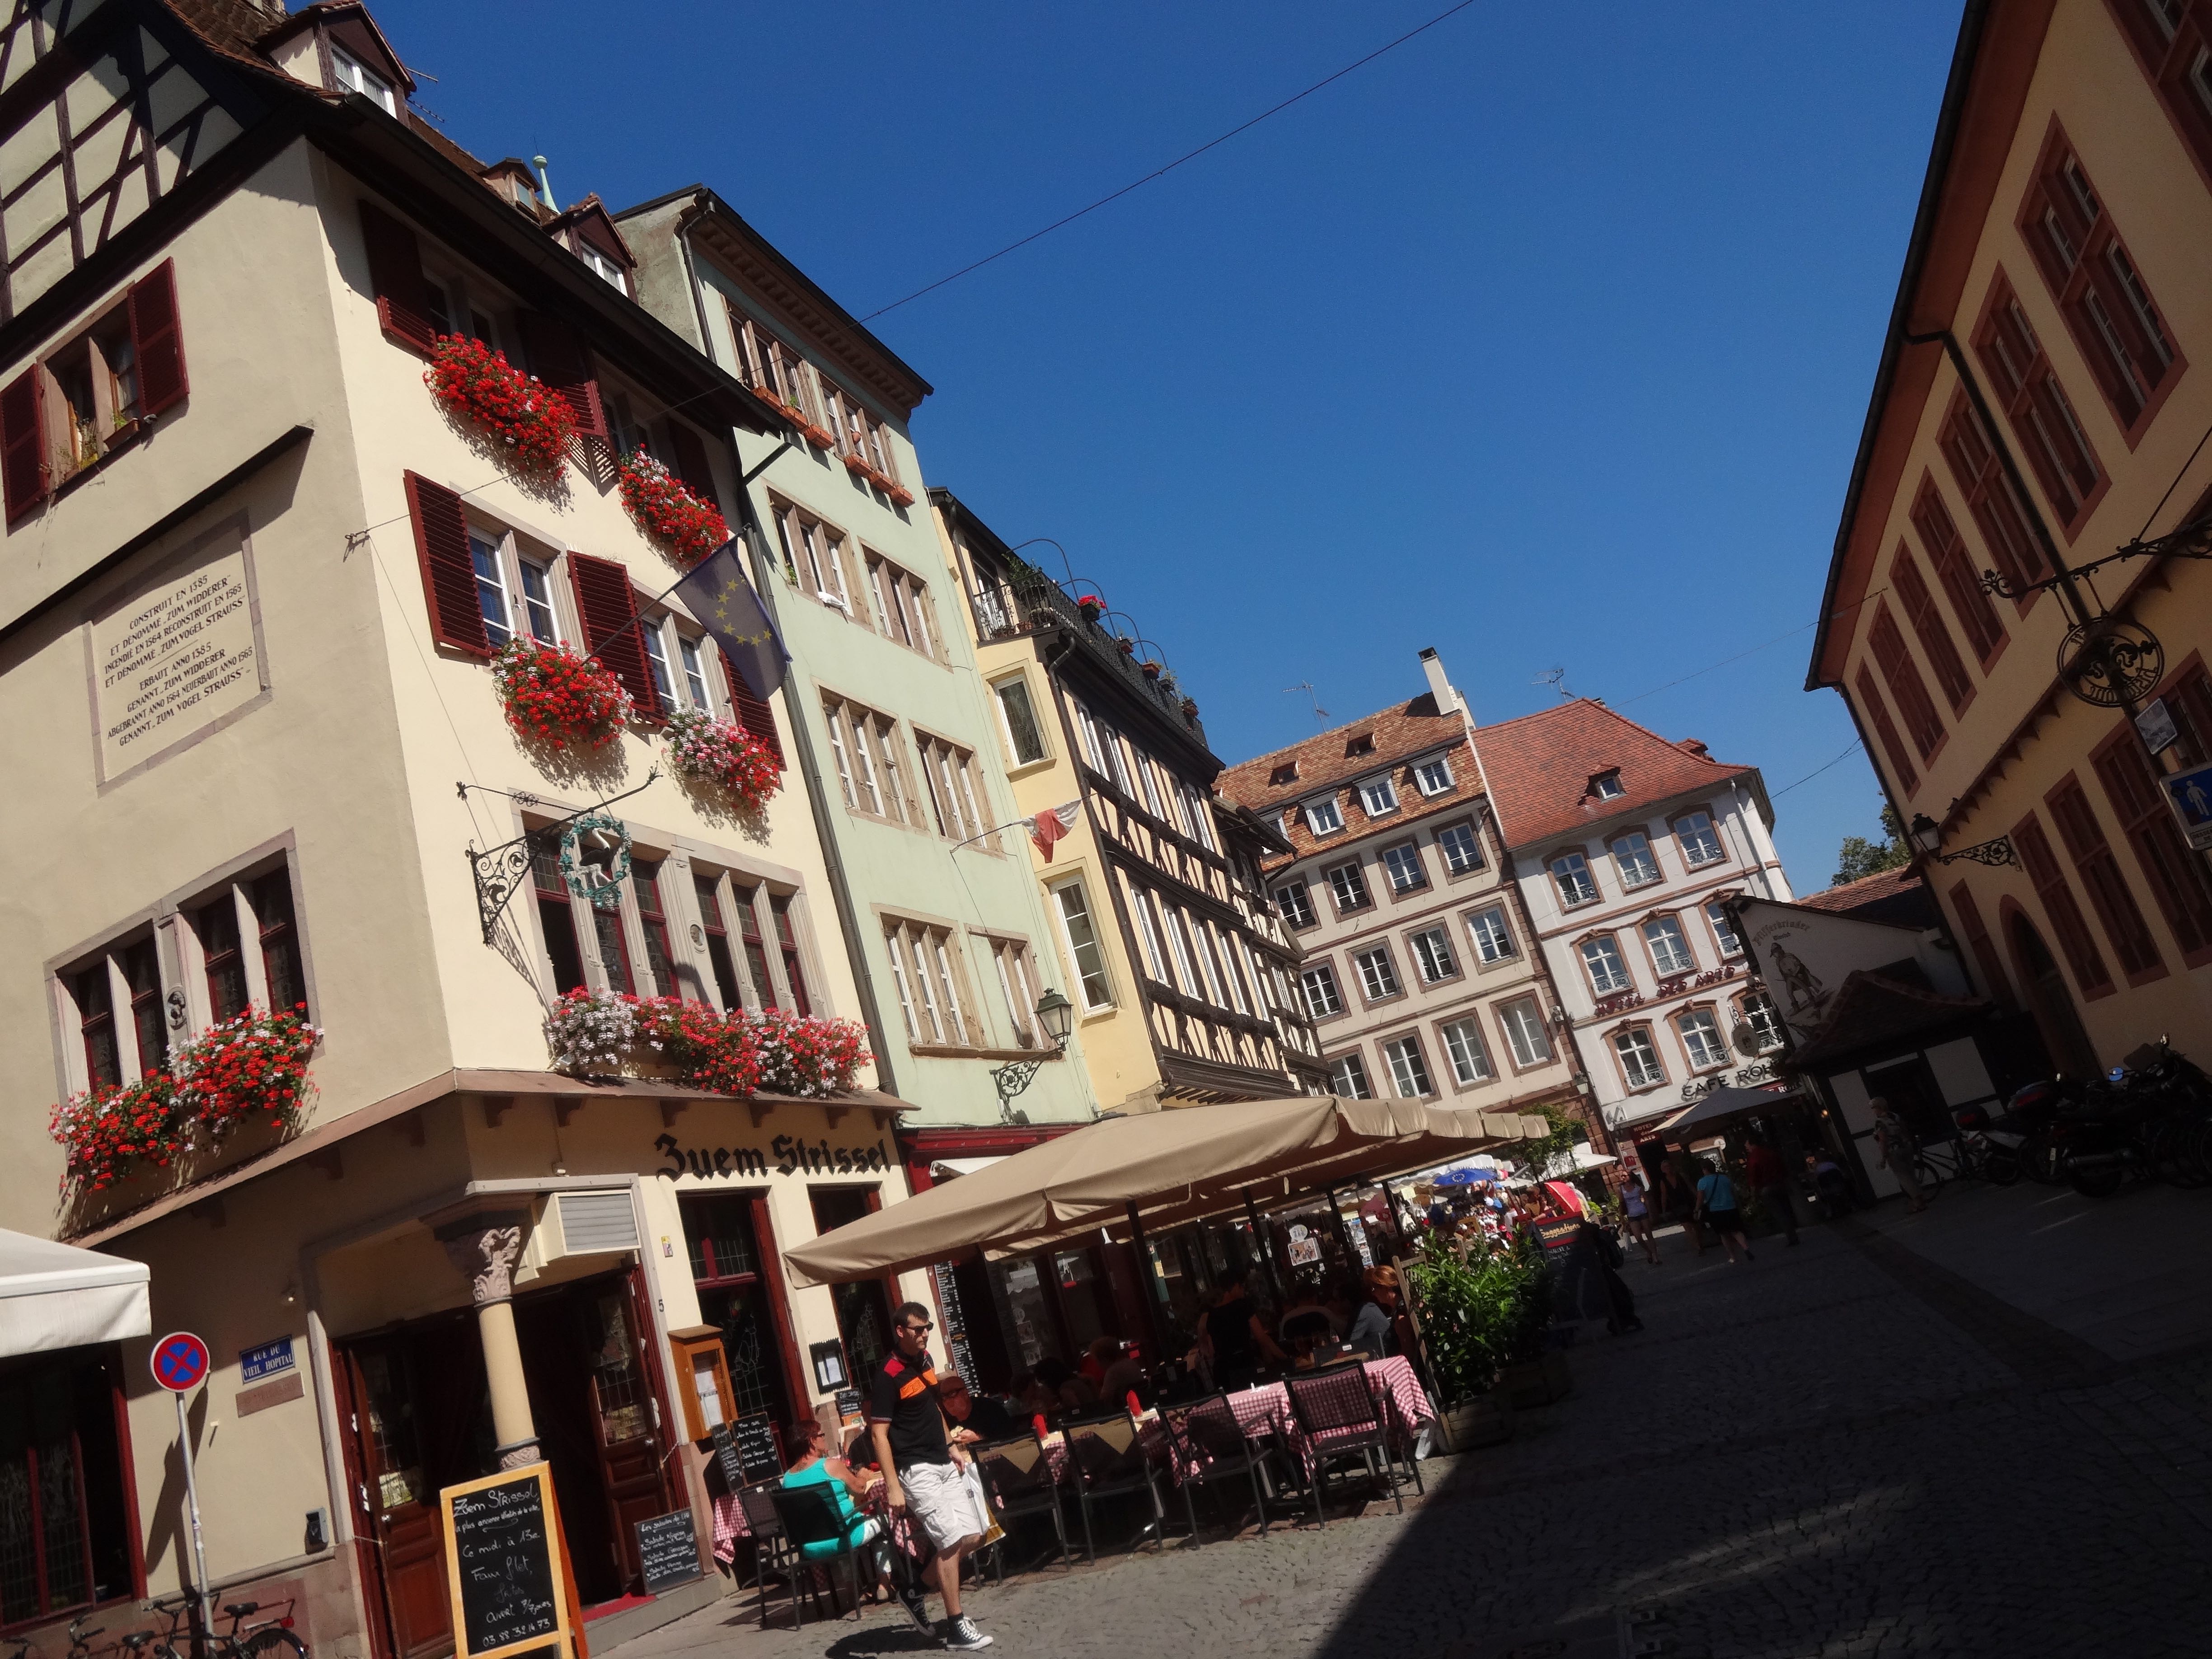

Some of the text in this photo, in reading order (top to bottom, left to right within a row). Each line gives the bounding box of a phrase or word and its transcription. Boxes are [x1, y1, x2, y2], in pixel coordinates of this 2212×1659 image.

[129, 575, 207, 629] CONSTRUIT EN 1385
[136, 642, 144, 655] EN
[164, 600, 212, 637] RECONSTRUIT
[215, 594, 224, 606] EN
[226, 583, 242, 600] 1565
[105, 675, 114, 688] ET
[179, 622, 205, 640] VOGEL
[110, 643, 119, 656] ET
[139, 642, 211, 691] ERBAUT ANNO 1385
[108, 709, 146, 739] ABGEBRANNT
[149, 699, 164, 715] ANNO
[181, 667, 218, 695] NEUERBAUT
[220, 657, 237, 673] ANNO
[238, 647, 253, 662] 1565
[127, 687, 159, 712] GENANNT
[183, 649, 225, 677] WIDDERER
[120, 720, 152, 746] GENANNT
[177, 693, 202, 712] VOGEL
[1695, 965, 1735, 988] ARTS
[1633, 1123, 1654, 1132] HOTEL
[1640, 1134, 1656, 1143] ARTS
[654, 1133, 893, 1183] Zuem Strissel
[244, 1353, 294, 1377] VIEIL HOPITAL
[253, 1344, 280, 1362] RUE DU
[454, 1498, 486, 1518] Zuem
[537, 1618, 550, 1629] 73
